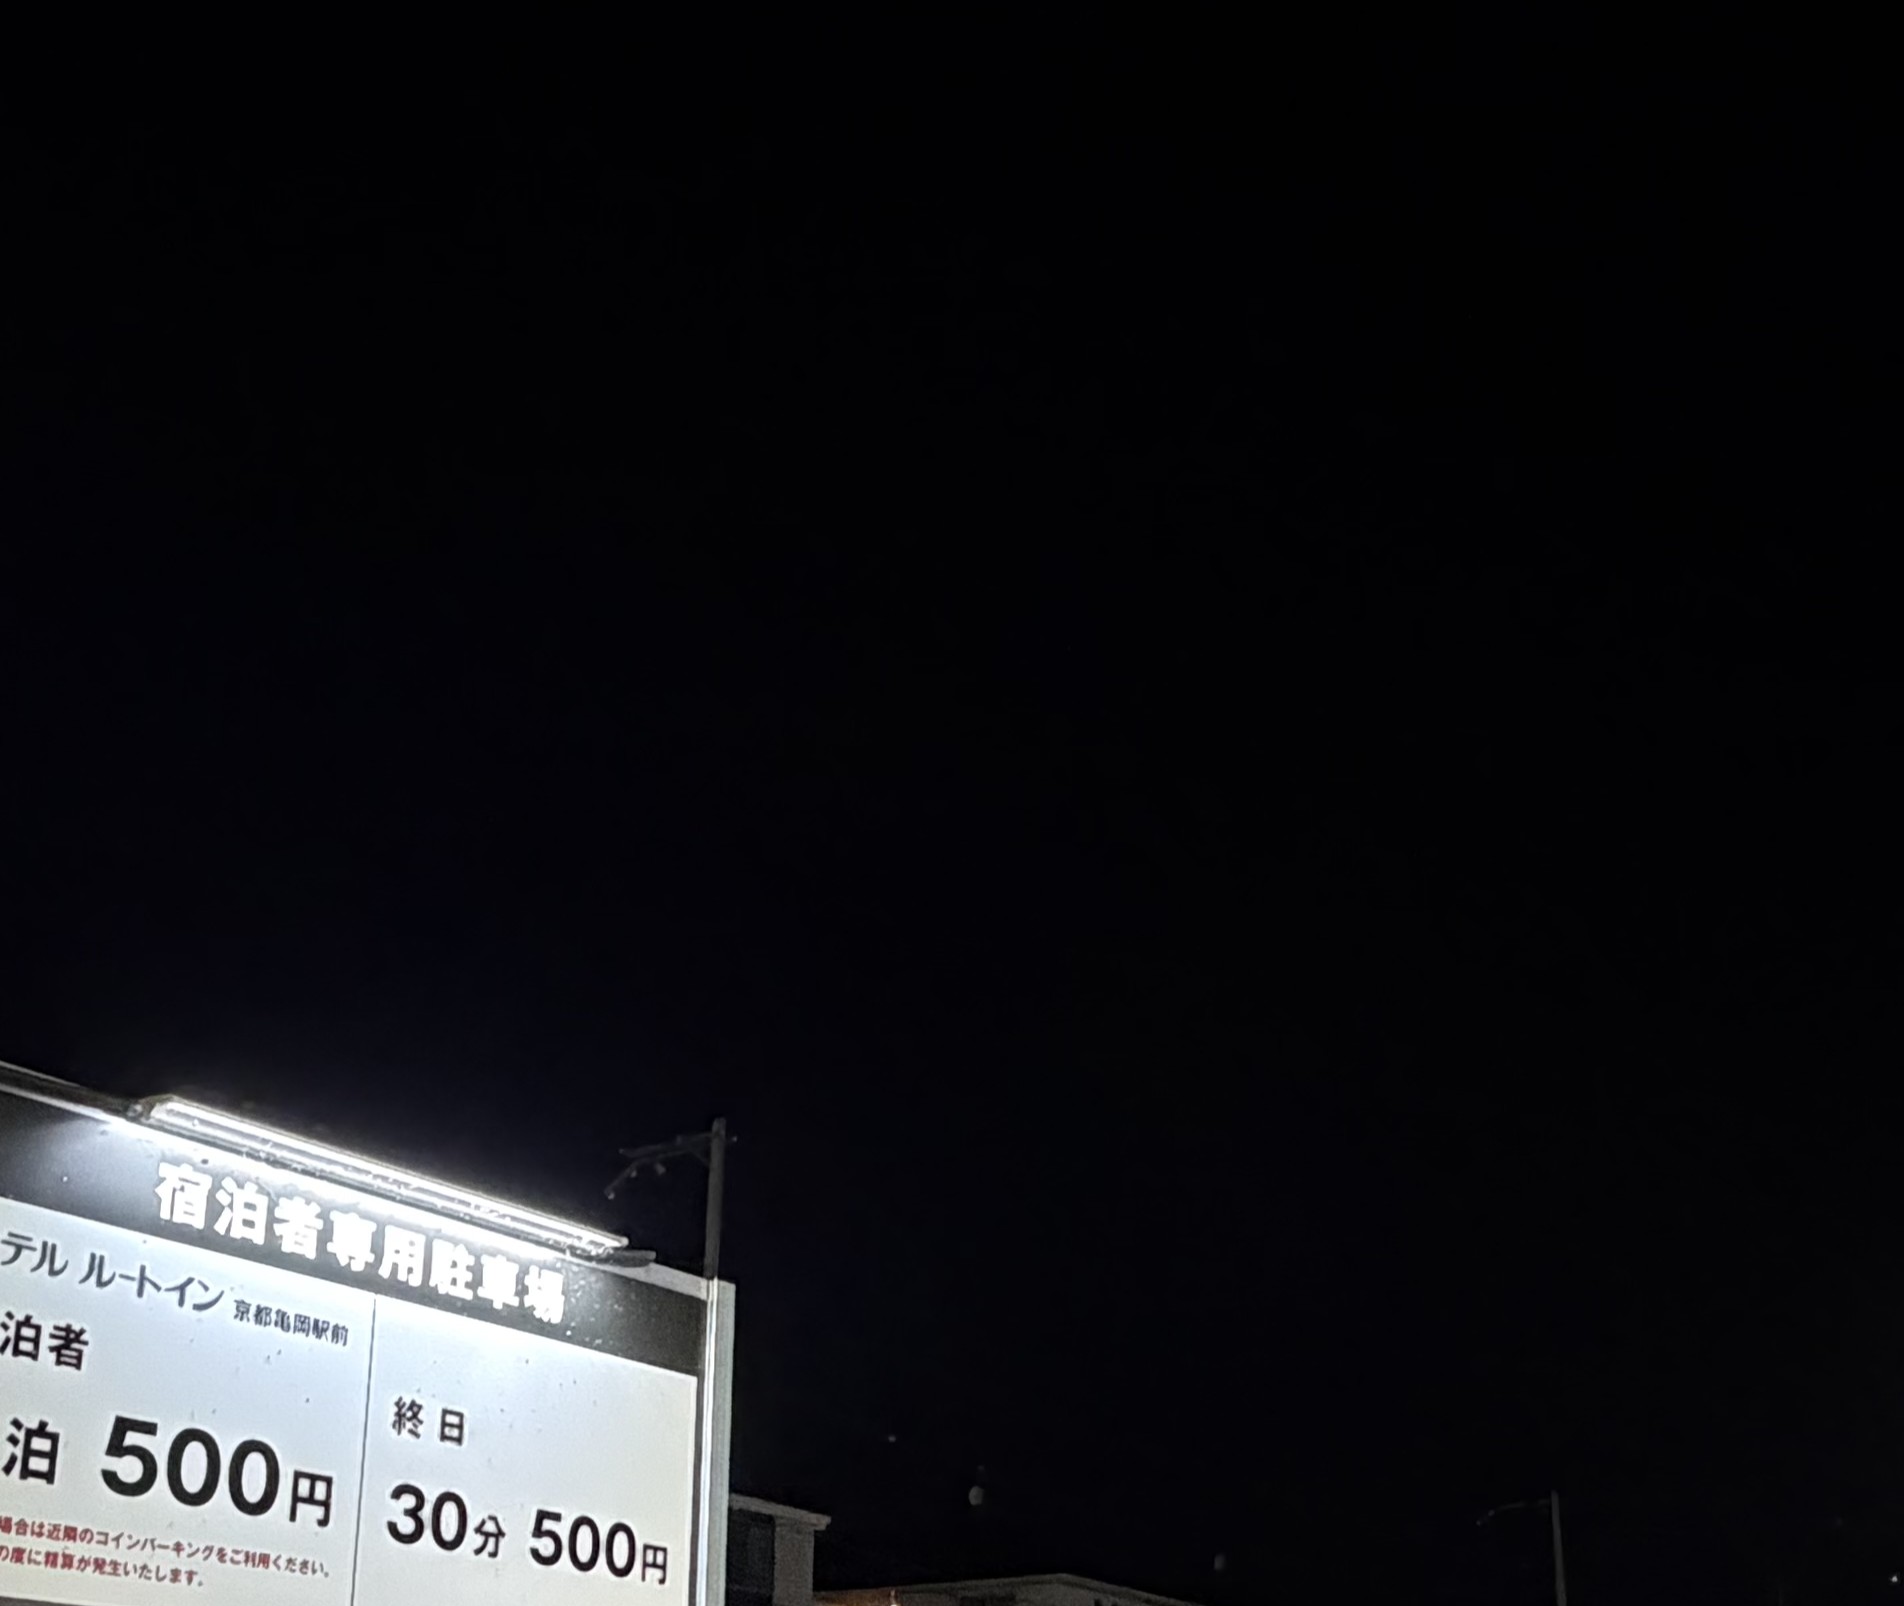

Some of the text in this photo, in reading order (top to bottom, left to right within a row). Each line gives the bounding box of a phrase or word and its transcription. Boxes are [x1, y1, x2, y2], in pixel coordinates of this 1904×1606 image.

[154, 1161, 566, 1324] 宿泊者専用駐車場
[79, 1252, 225, 1311] ルートイン
[233, 1299, 349, 1347] 京都亀岡駅前
[100, 1415, 334, 1528] 500円
[386, 1483, 668, 1585] 30分 500円
